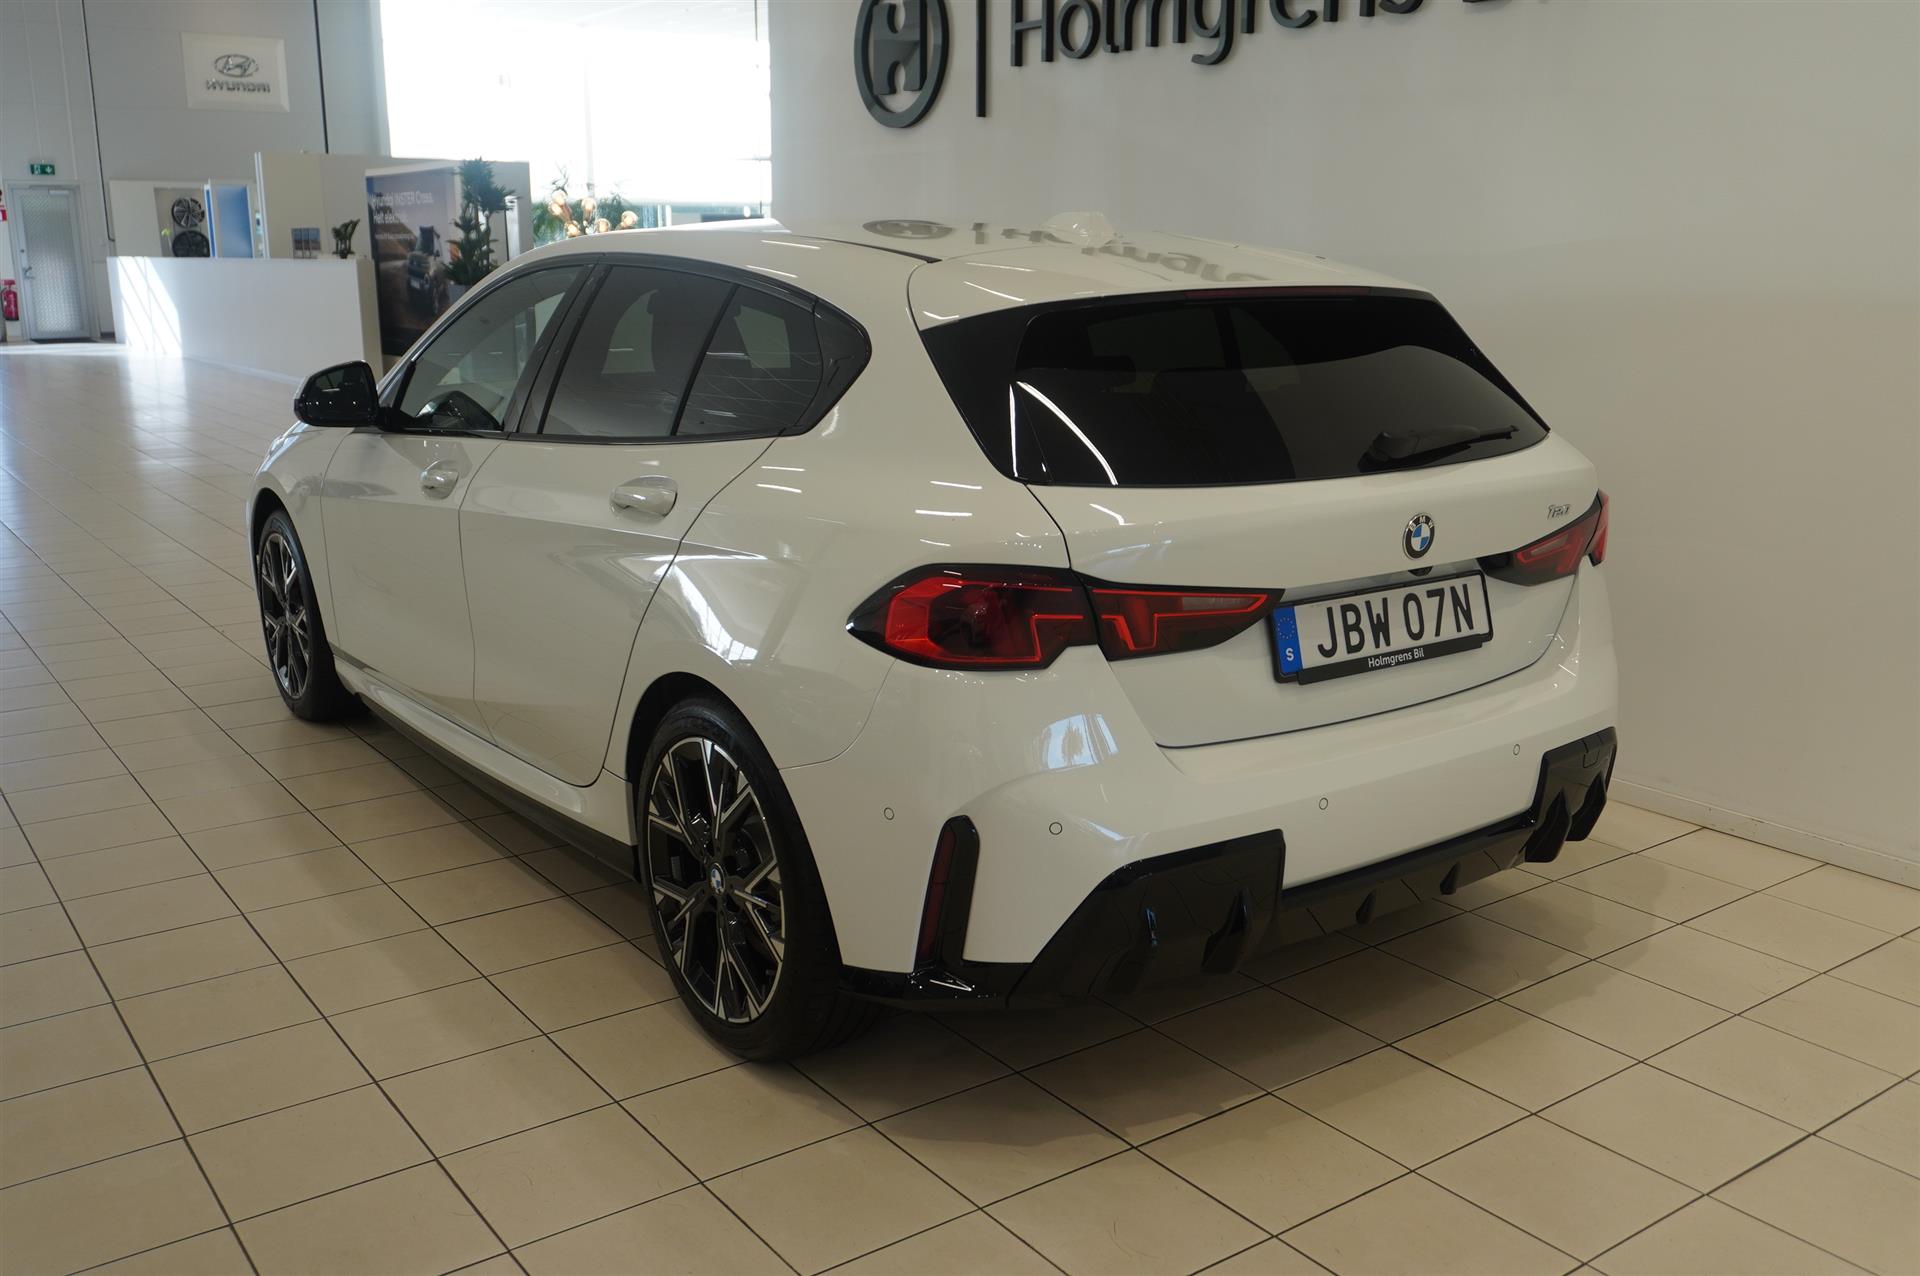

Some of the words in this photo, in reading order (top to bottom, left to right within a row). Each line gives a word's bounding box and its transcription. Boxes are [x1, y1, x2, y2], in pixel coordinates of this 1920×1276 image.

[1010, 0, 1425, 67] Holmgre
[206, 79, 271, 93] HYUNDAI
[1408, 515, 1434, 532] BMW
[1317, 597, 1391, 658] JBW
[1402, 583, 1475, 641] 07N
[1285, 647, 1295, 662] S
[1367, 652, 1413, 668] Holmgrens
[1413, 647, 1425, 659] Bil
